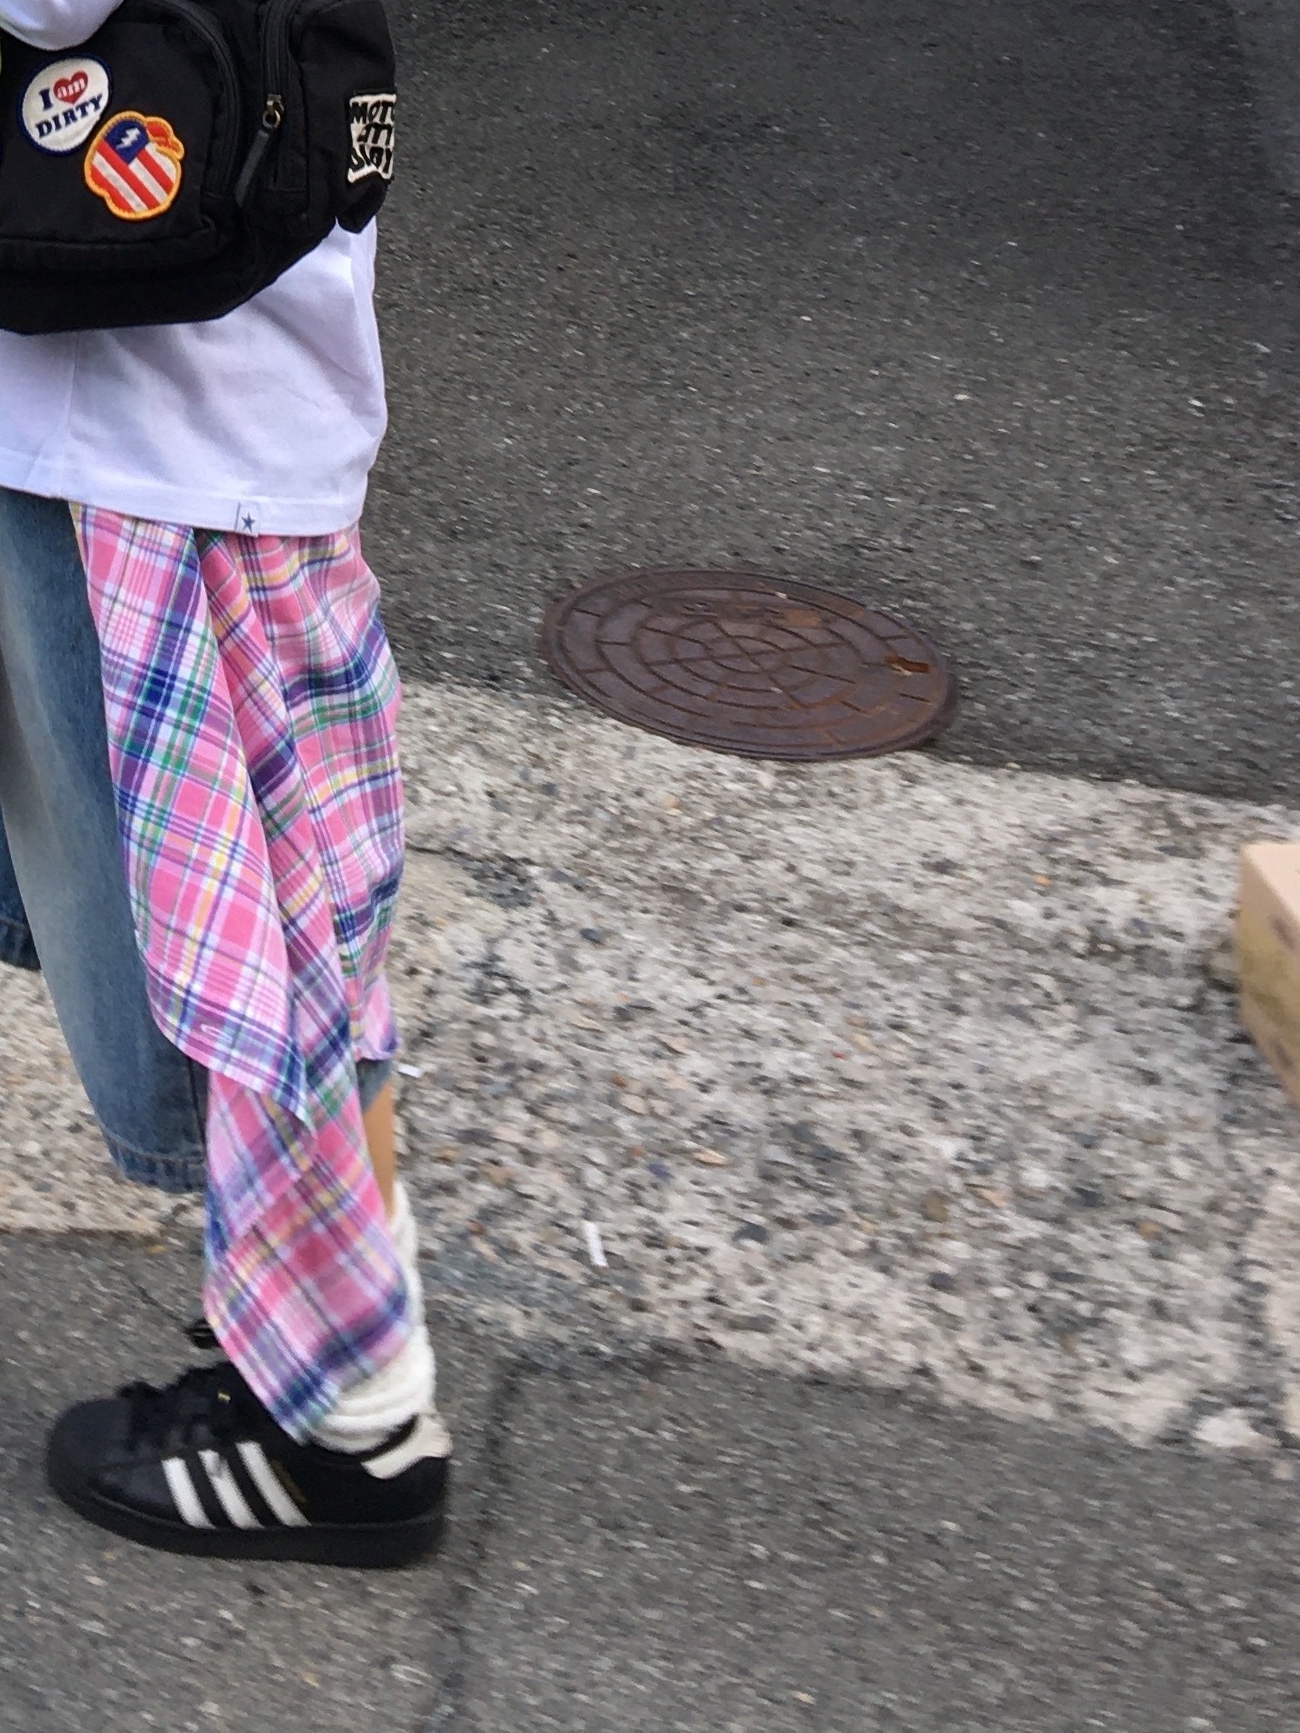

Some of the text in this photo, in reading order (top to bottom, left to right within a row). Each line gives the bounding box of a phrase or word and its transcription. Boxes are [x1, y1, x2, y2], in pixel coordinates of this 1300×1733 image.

[39, 78, 86, 111] I am
[35, 92, 103, 139] DIRTY
